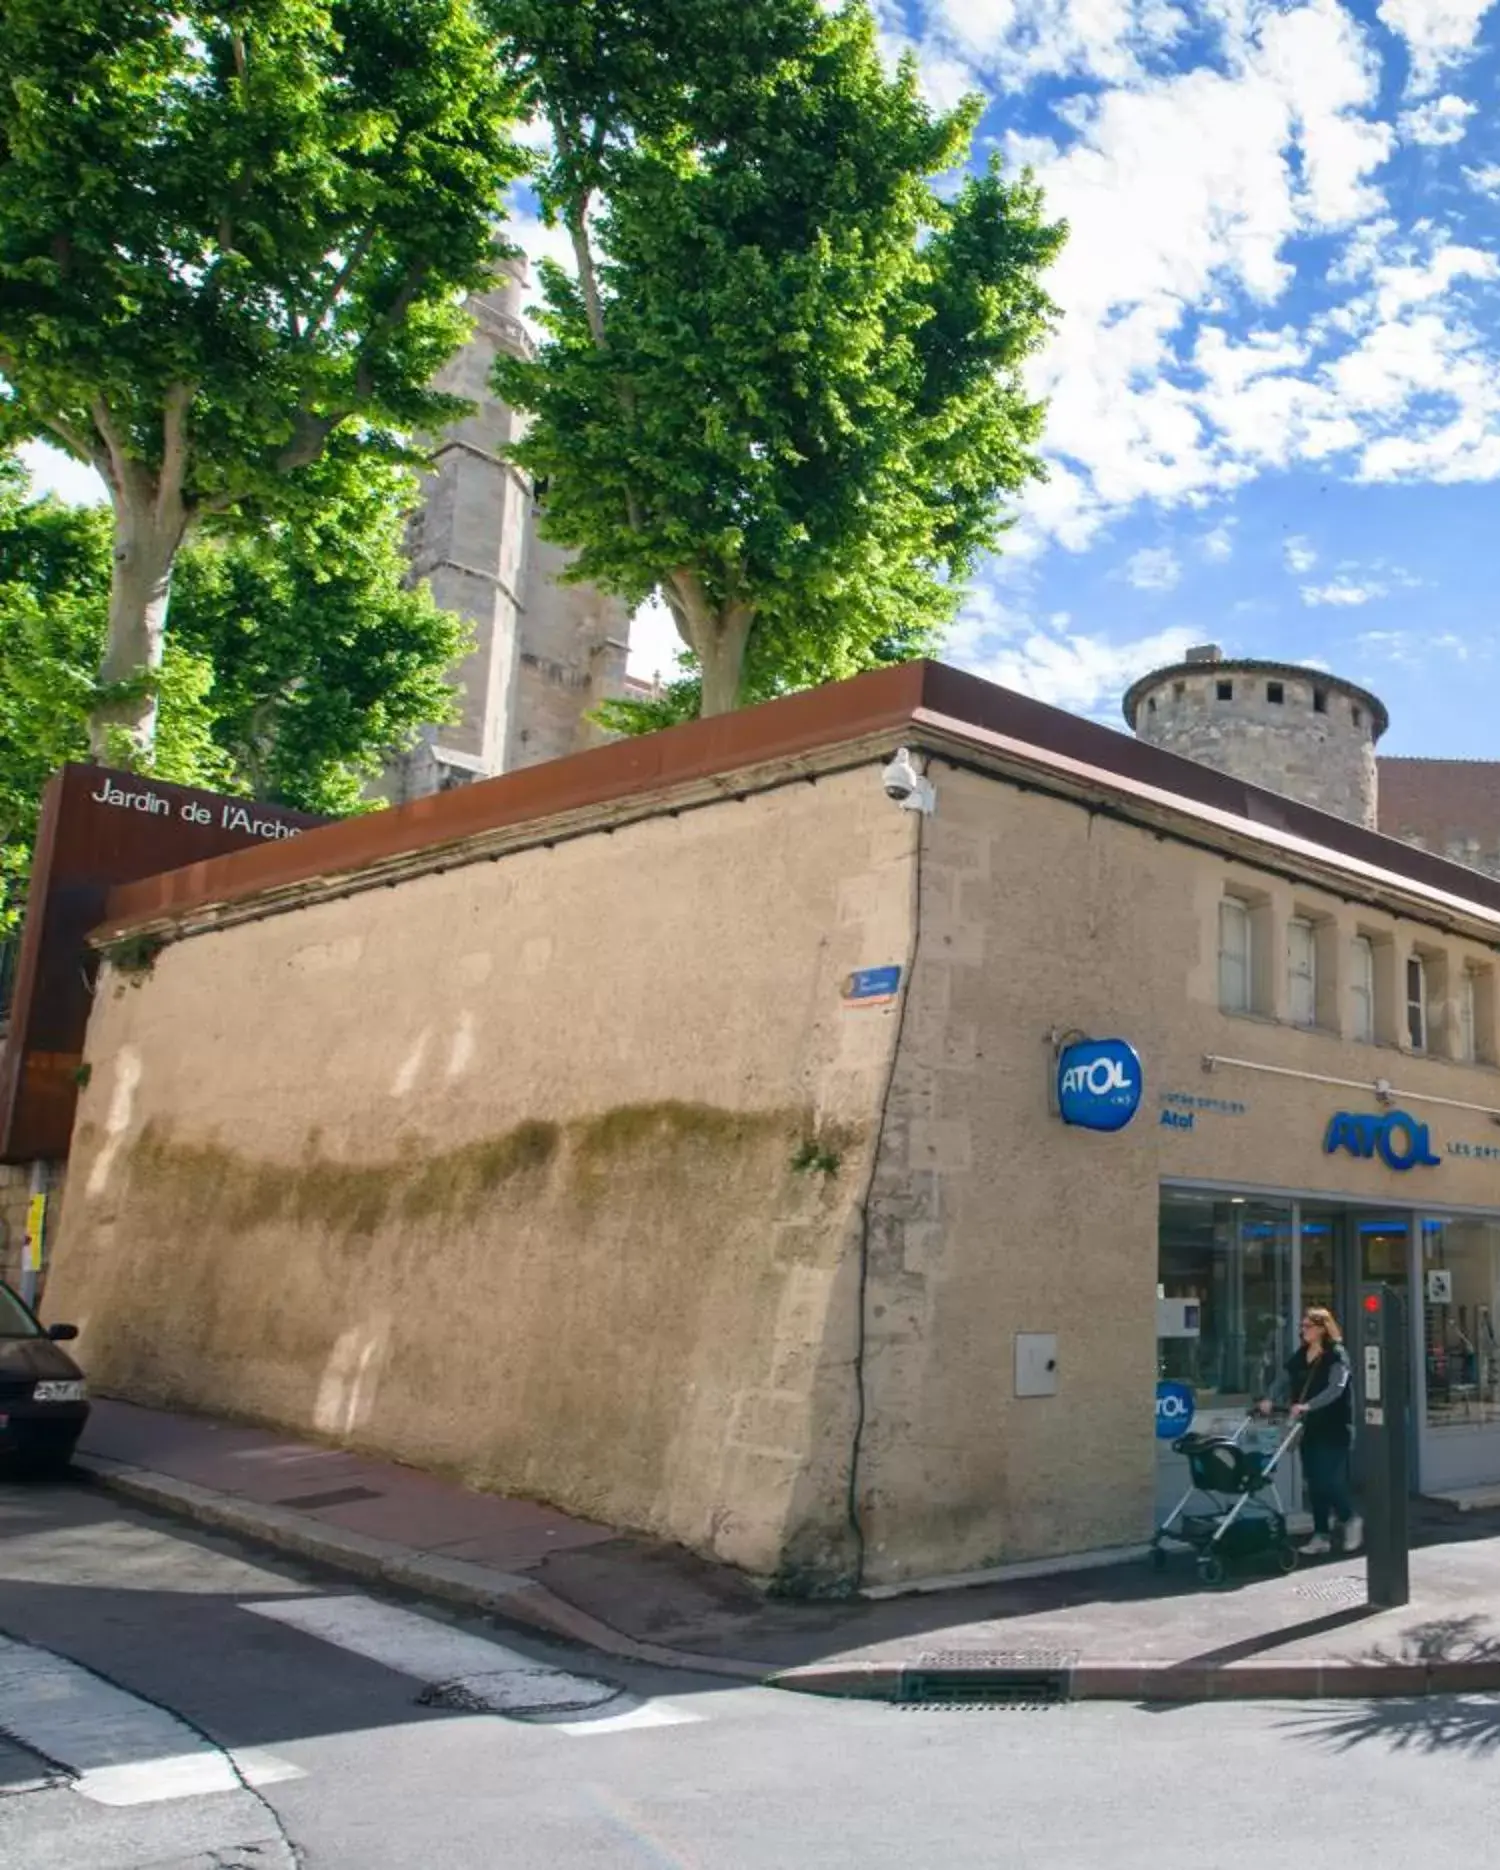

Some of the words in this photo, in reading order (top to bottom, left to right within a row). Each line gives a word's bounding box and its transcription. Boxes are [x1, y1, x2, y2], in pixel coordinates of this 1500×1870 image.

[91, 777, 170, 817] Jardin
[180, 801, 211, 825] de
[1061, 1056, 1133, 1096] ATOL
[1159, 1109, 1196, 1130] Atol
[1324, 1110, 1441, 1171] ATOL
[1155, 1394, 1189, 1417] TOL
